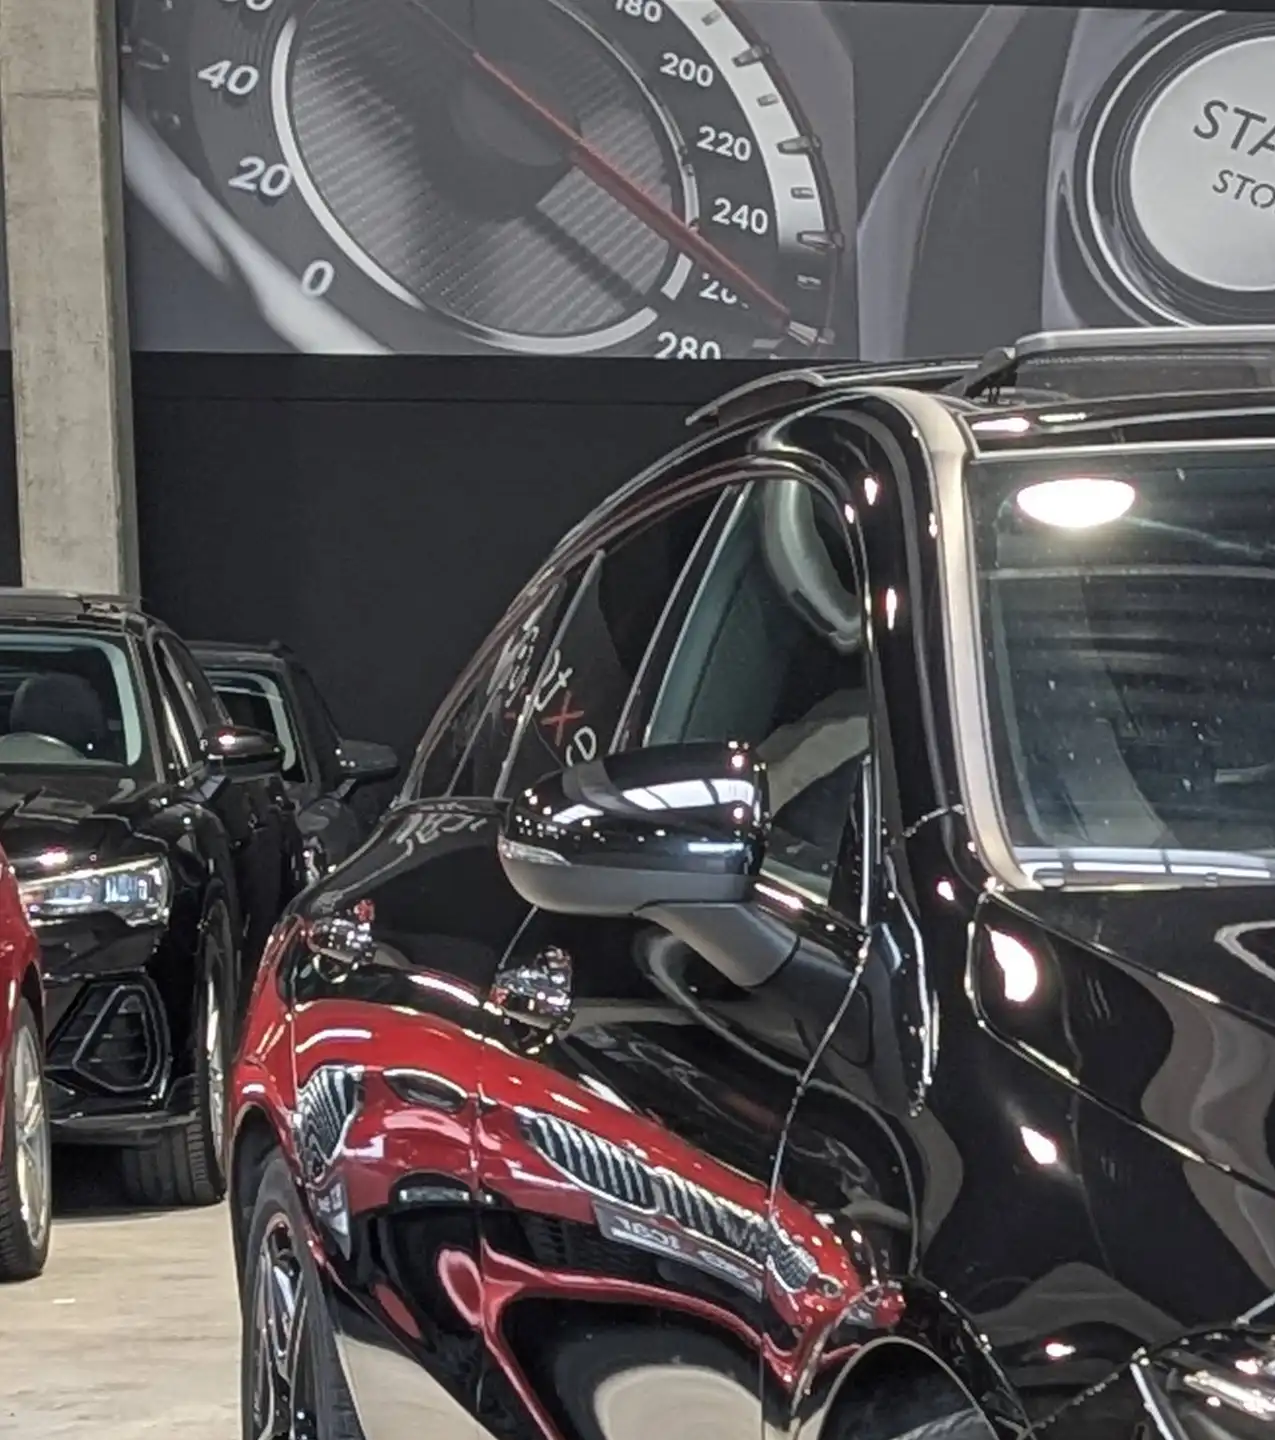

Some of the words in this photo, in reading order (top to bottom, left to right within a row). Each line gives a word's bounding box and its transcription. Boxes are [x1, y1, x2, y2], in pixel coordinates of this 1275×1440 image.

[198, 60, 259, 96] 40
[659, 52, 714, 87] 200
[697, 126, 751, 162] 220
[228, 156, 293, 197] 20
[712, 198, 769, 235] 240
[300, 260, 335, 297] 0
